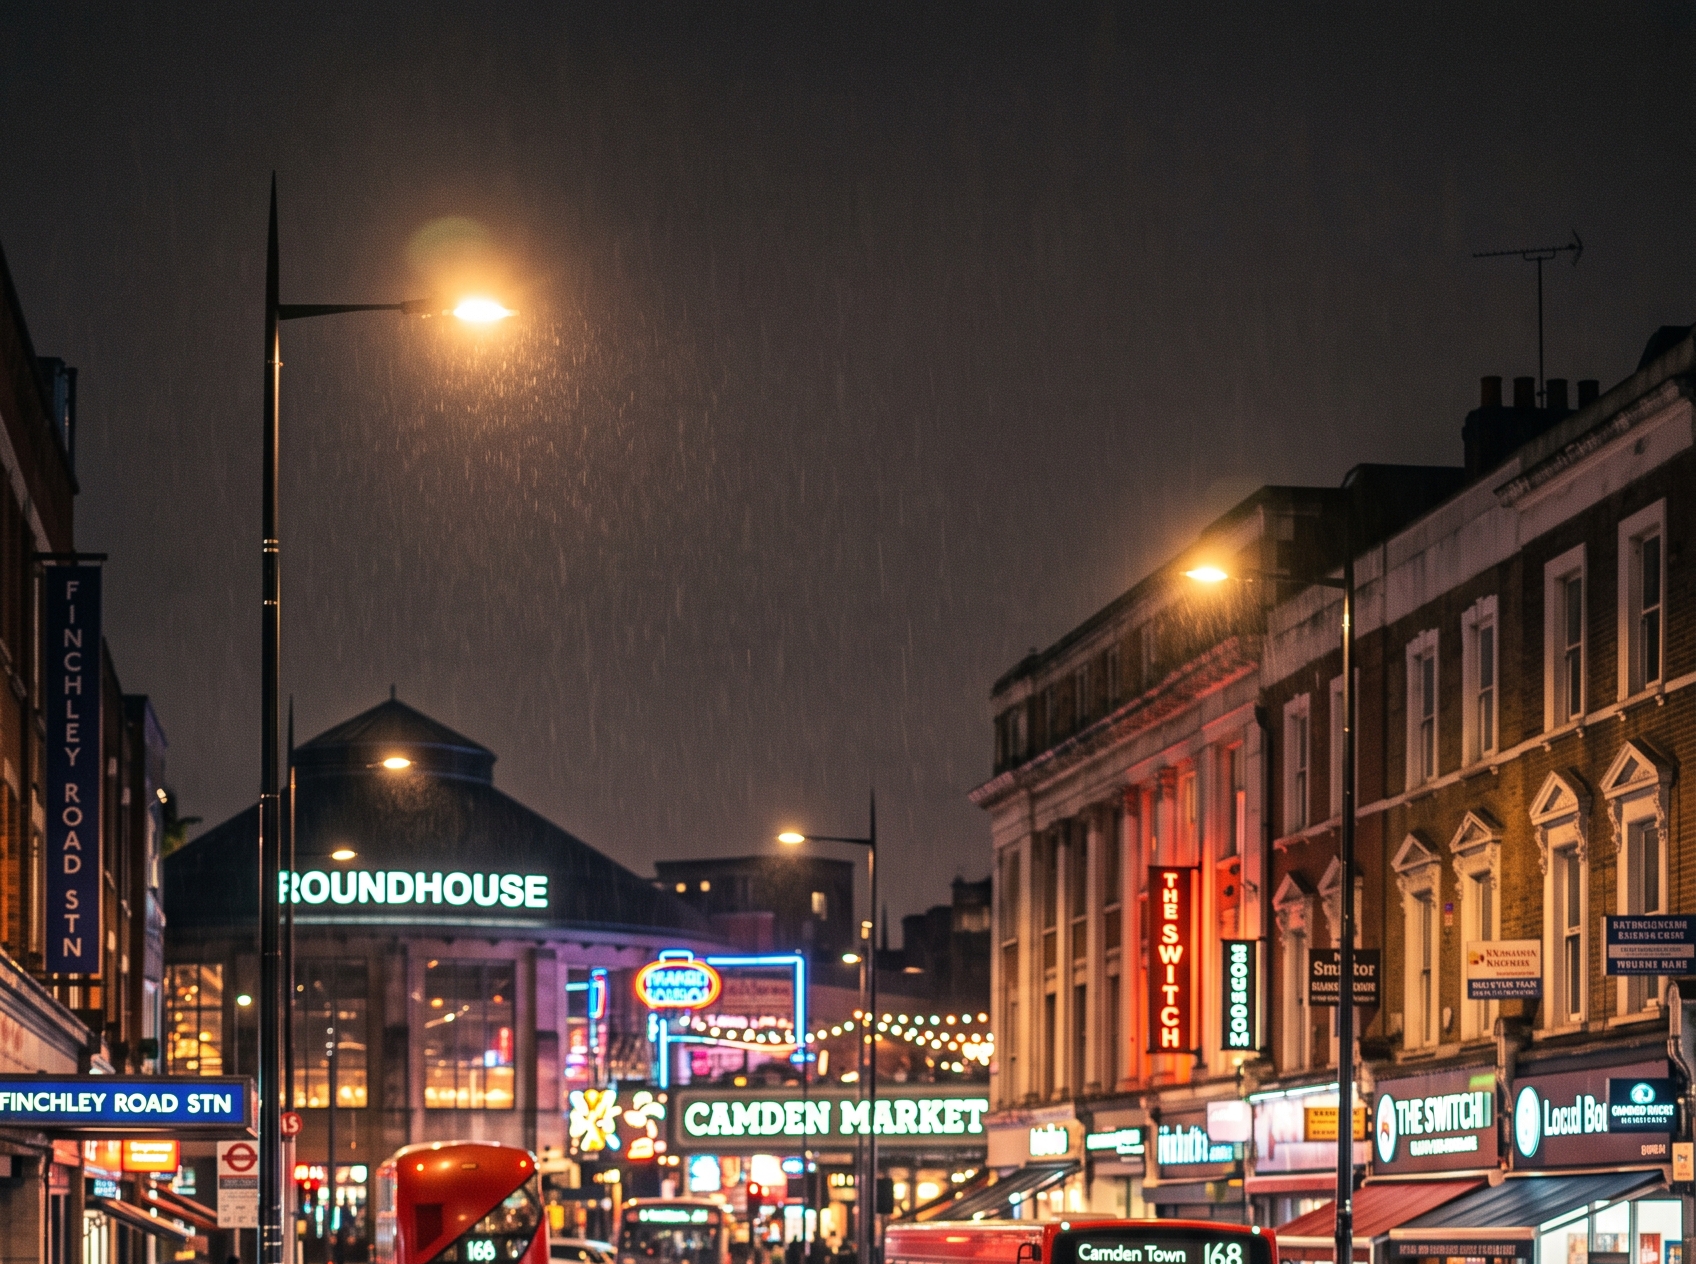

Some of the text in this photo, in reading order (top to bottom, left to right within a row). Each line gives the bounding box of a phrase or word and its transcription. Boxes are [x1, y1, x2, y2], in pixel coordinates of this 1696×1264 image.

[63, 581, 83, 958] FINCHLEY ROAD STN
[278, 870, 549, 908] ROUNDHOUSE
[1157, 872, 1184, 1049] THE SWITCH
[0, 1092, 232, 1114] FINCHLEY ROAD STN
[684, 1098, 989, 1136] CAMDEN MARKET
[1395, 1099, 1424, 1136] THE
[1078, 1243, 1142, 1262] Camden
[1144, 1244, 1187, 1263] Town
